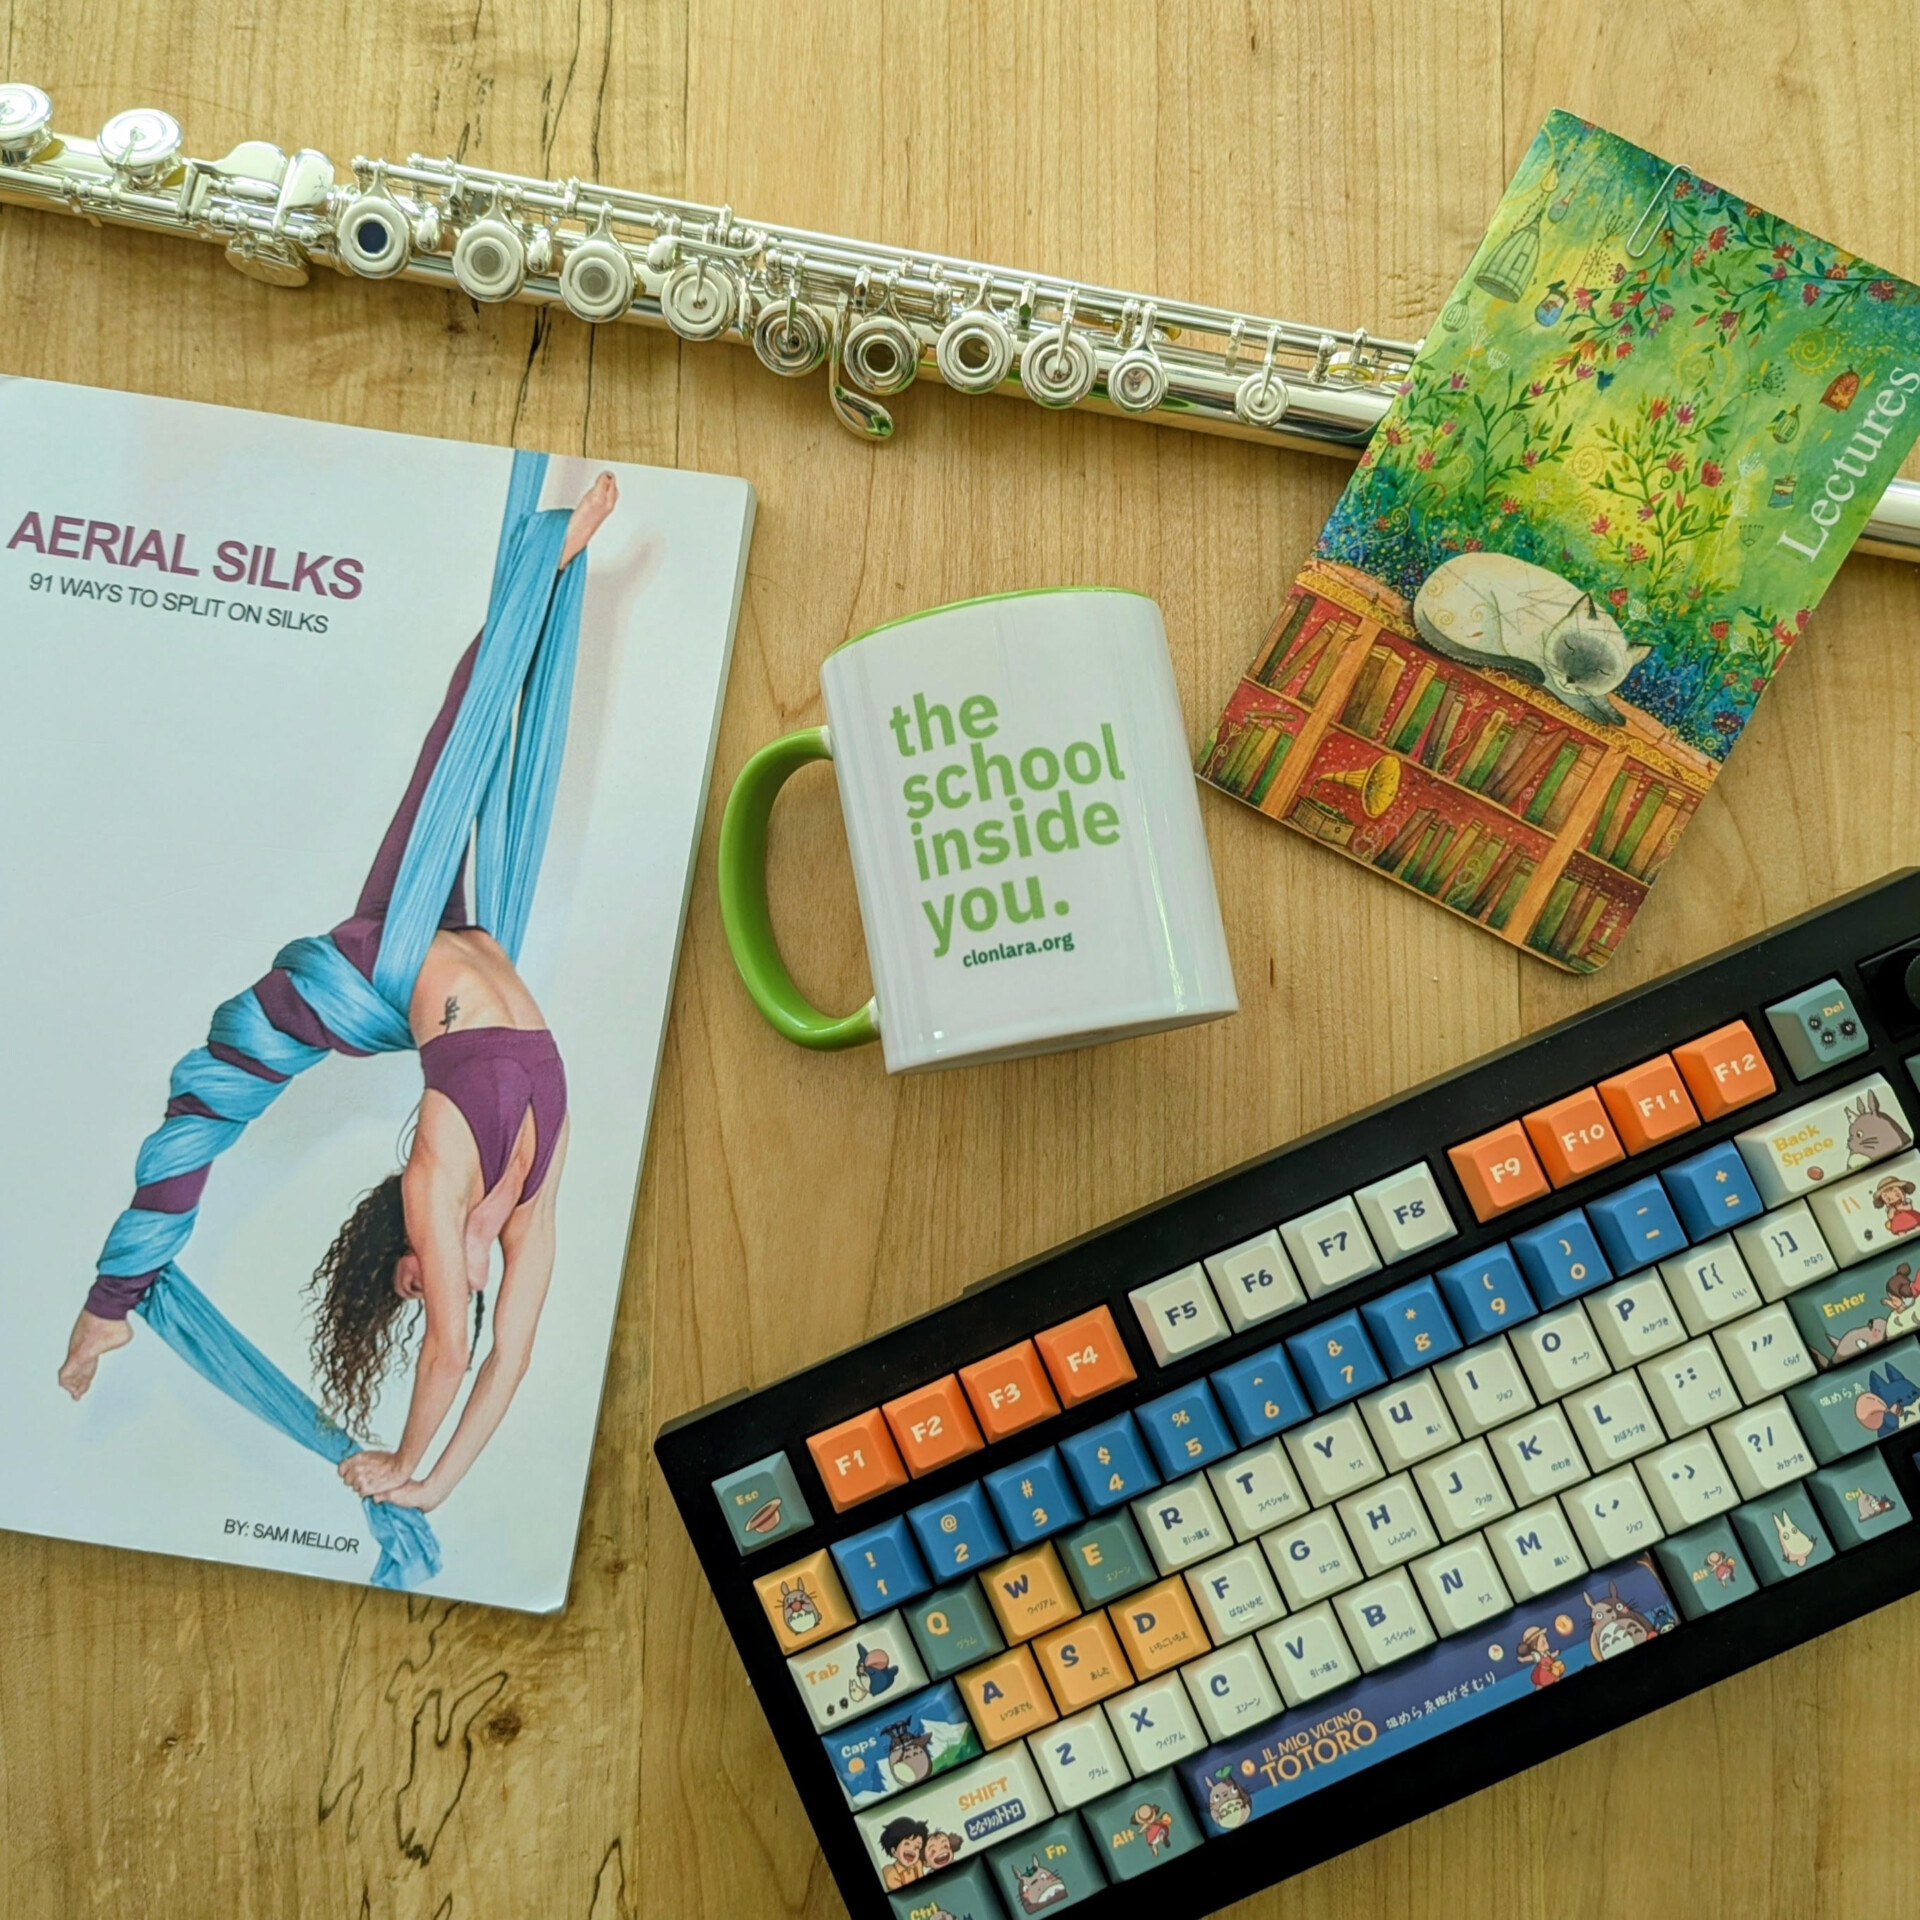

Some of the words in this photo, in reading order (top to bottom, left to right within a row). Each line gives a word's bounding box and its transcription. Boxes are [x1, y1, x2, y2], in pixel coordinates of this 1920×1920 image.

[1776, 367, 1920, 563] Lectures
[6, 510, 200, 577] AERIAL
[212, 540, 364, 600] SILKS
[29, 572, 53, 593] 91
[60, 576, 123, 603] WAYS
[128, 586, 158, 608] TO
[162, 592, 225, 619] SPLIT
[228, 602, 262, 624] ON
[266, 608, 329, 634] SILKS
[889, 692, 999, 757] the
[903, 723, 1125, 819] school
[910, 789, 1120, 881] inside
[921, 875, 1070, 958] you.
[963, 932, 1075, 968] clonlara.org
[1822, 1001, 1845, 1018] Del
[1713, 1053, 1757, 1083] F12
[1638, 1089, 1680, 1118] F11
[1561, 1123, 1605, 1152] F10
[1772, 1123, 1820, 1152] Back
[1780, 1136, 1835, 1168] Space
[1489, 1156, 1521, 1184] F9
[1715, 1169, 1728, 1184] +
[1393, 1199, 1426, 1226] F8
[1725, 1194, 1740, 1208] =
[1317, 1230, 1348, 1258] F7
[1241, 1269, 1273, 1293] F6
[1164, 1300, 1198, 1327] F5
[1490, 1297, 1507, 1315] 9
[1615, 1297, 1636, 1322] P
[1821, 1291, 1867, 1318] Enter
[1327, 1339, 1343, 1357] &
[1414, 1332, 1431, 1352] 8
[1541, 1331, 1561, 1353] O
[1066, 1345, 1099, 1373] F4
[1340, 1365, 1354, 1384] 7
[1465, 1370, 1479, 1391] I
[988, 1382, 1021, 1410] F3
[1171, 1410, 1190, 1428] %
[1264, 1400, 1280, 1419] 6
[1592, 1404, 1613, 1425] L
[910, 1415, 944, 1443] F2
[1097, 1446, 1111, 1466] $
[1185, 1437, 1203, 1457] 5
[1313, 1435, 1334, 1458] Y
[1516, 1434, 1543, 1462] K
[835, 1449, 866, 1477] F1
[1021, 1480, 1034, 1498] #
[1108, 1473, 1124, 1492] 4
[1235, 1471, 1254, 1495] T
[1448, 1471, 1463, 1494] J
[940, 1514, 958, 1533] @
[1032, 1508, 1048, 1527] 3
[1158, 1506, 1183, 1530] R
[1366, 1504, 1391, 1530] H
[224, 1518, 250, 1537] BY:
[253, 1523, 290, 1543] SAM
[291, 1530, 360, 1553] MELLOR
[1515, 1531, 1543, 1556] M
[865, 1551, 877, 1568] !
[954, 1543, 969, 1564] 2
[1081, 1542, 1104, 1567] E
[1289, 1539, 1310, 1561] G
[876, 1579, 889, 1596] 1
[1002, 1574, 1029, 1599] W
[1211, 1575, 1230, 1599] F
[1439, 1567, 1464, 1594] N
[1692, 1568, 1709, 1583] Alt
[926, 1611, 950, 1636] Q
[1132, 1611, 1156, 1634] D
[1361, 1603, 1387, 1628] B
[1060, 1644, 1080, 1668] S
[1284, 1636, 1304, 1659] V
[805, 1662, 840, 1686] Tab
[1210, 1673, 1230, 1697] C
[982, 1680, 1004, 1705] A
[1129, 1706, 1155, 1733] X
[1261, 1747, 1279, 1763] IL
[1277, 1731, 1310, 1757] MIO
[1309, 1707, 1362, 1738] VICINO
[840, 1736, 878, 1759] Caps
[1055, 1742, 1077, 1766] Z
[1260, 1719, 1378, 1787] TOTORO
[958, 1777, 1008, 1812] SHIFT
[968, 1803, 1022, 1838] となりのトトロ
[1111, 1828, 1136, 1849] Alt
[1045, 1844, 1067, 1860] Fn
[910, 1901, 939, 1920] Ctrl
